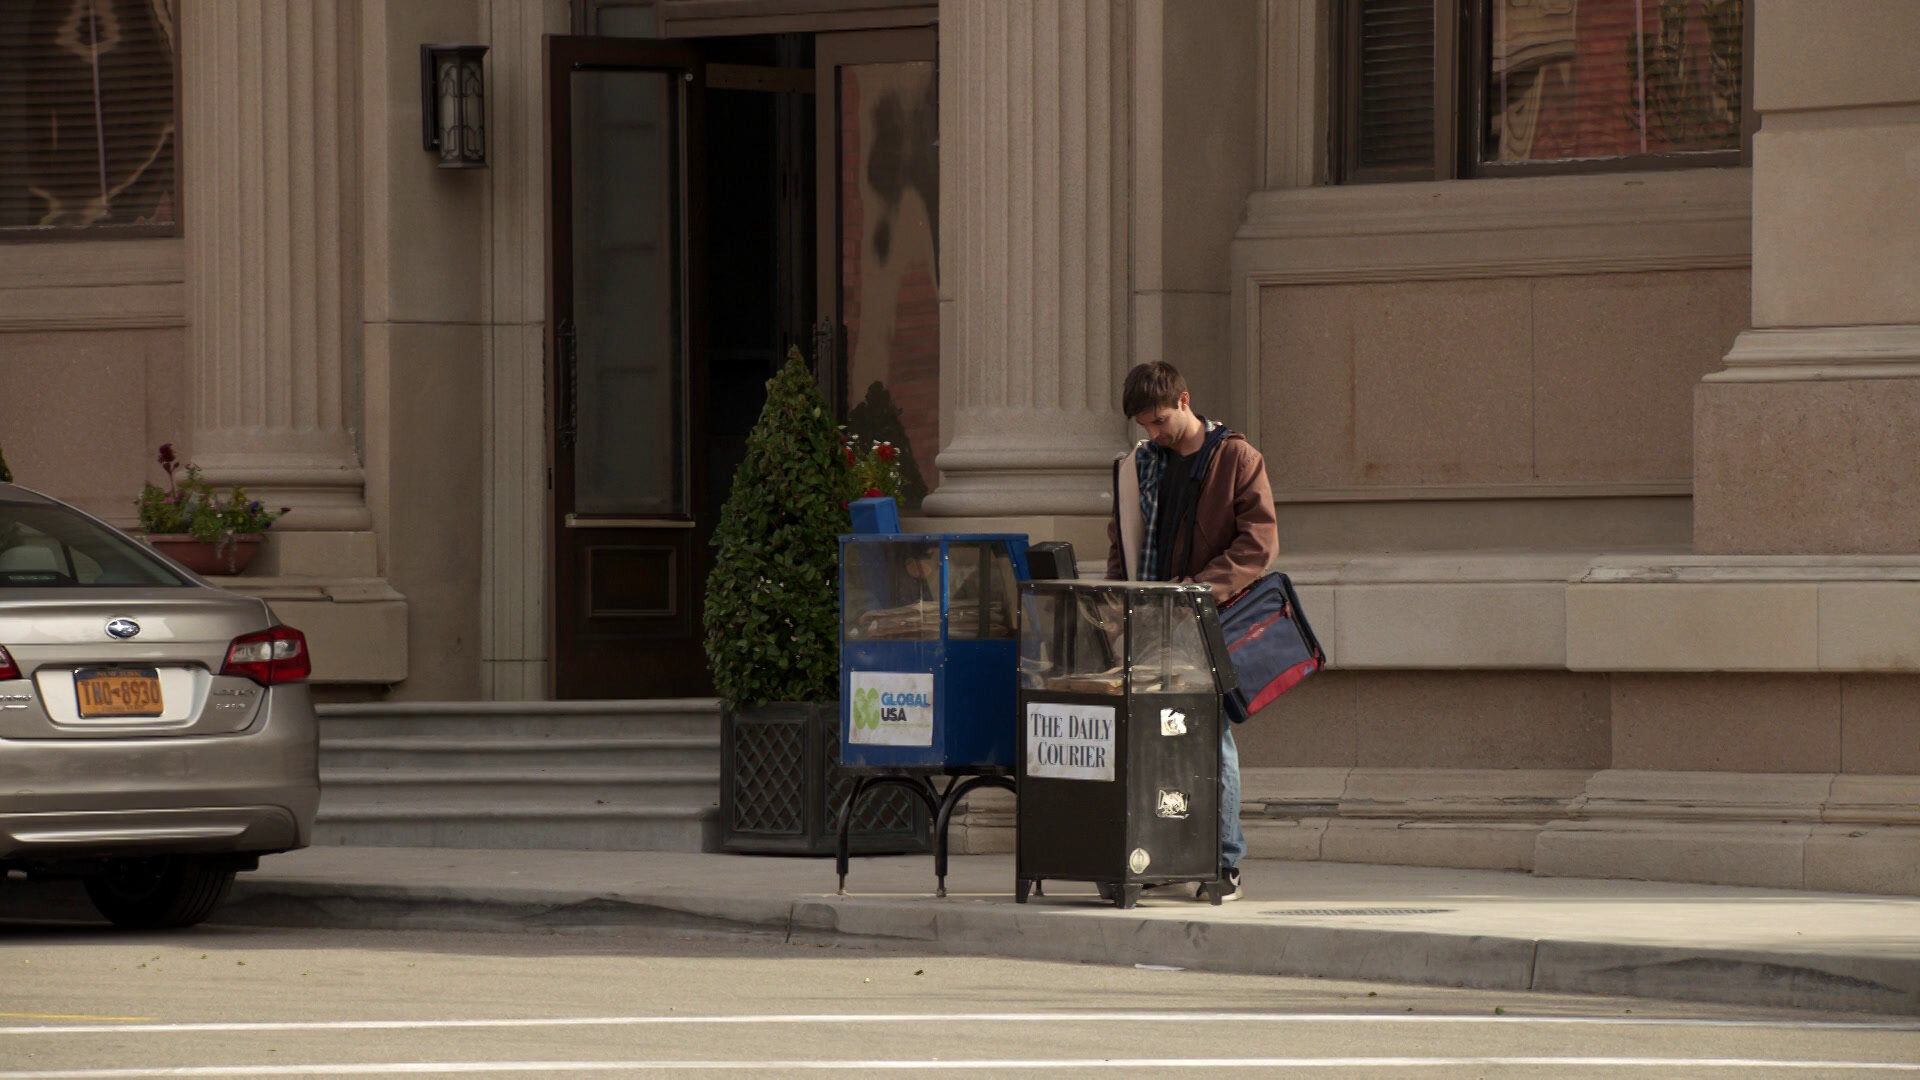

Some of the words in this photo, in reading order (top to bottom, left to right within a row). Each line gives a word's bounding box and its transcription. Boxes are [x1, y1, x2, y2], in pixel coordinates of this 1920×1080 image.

[881, 692, 931, 708] GLOBAL
[881, 707, 907, 722] USA
[1030, 713, 1063, 738] THE
[1068, 715, 1112, 740] DAILY
[1038, 741, 1106, 768] COURIER
